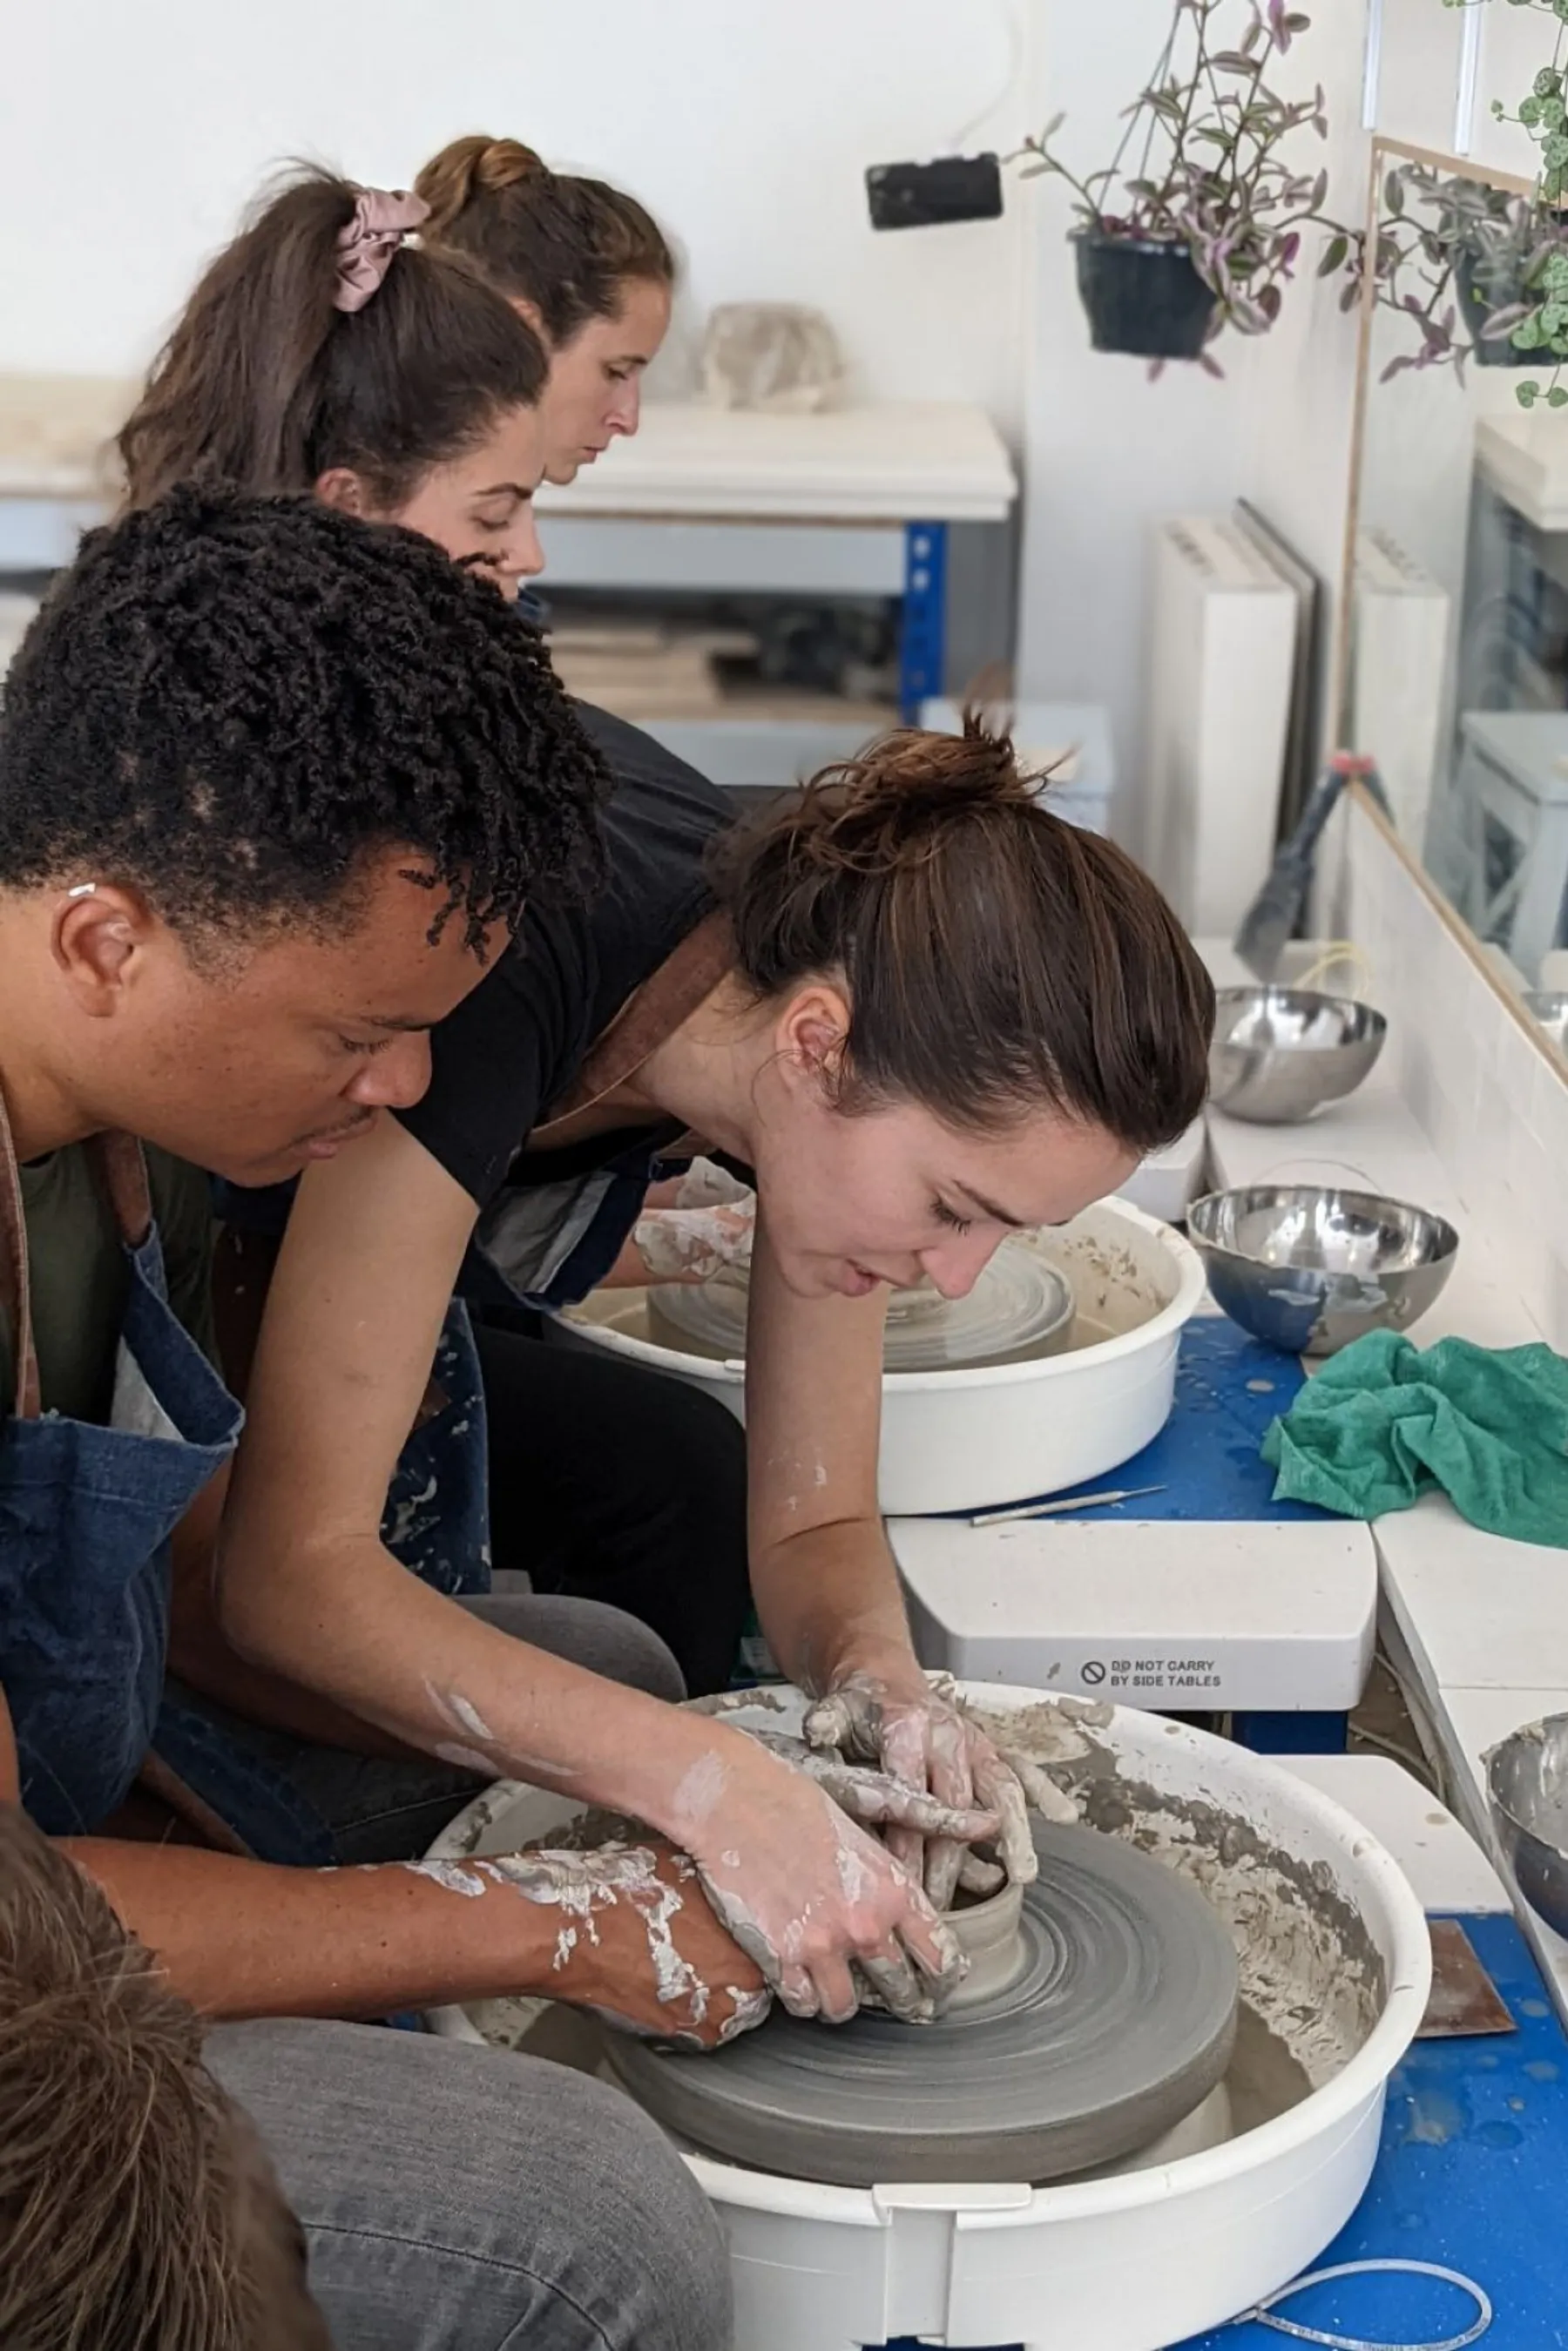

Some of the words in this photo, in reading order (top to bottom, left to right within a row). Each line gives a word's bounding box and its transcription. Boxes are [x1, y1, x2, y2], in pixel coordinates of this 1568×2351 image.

[1112, 1660, 1132, 1672] DO
[1135, 1660, 1164, 1672] NOT
[1167, 1660, 1215, 1672] CARRY
[1111, 1675, 1129, 1686] BY
[1132, 1675, 1164, 1686] SIDE
[1167, 1675, 1221, 1686] TABLES
